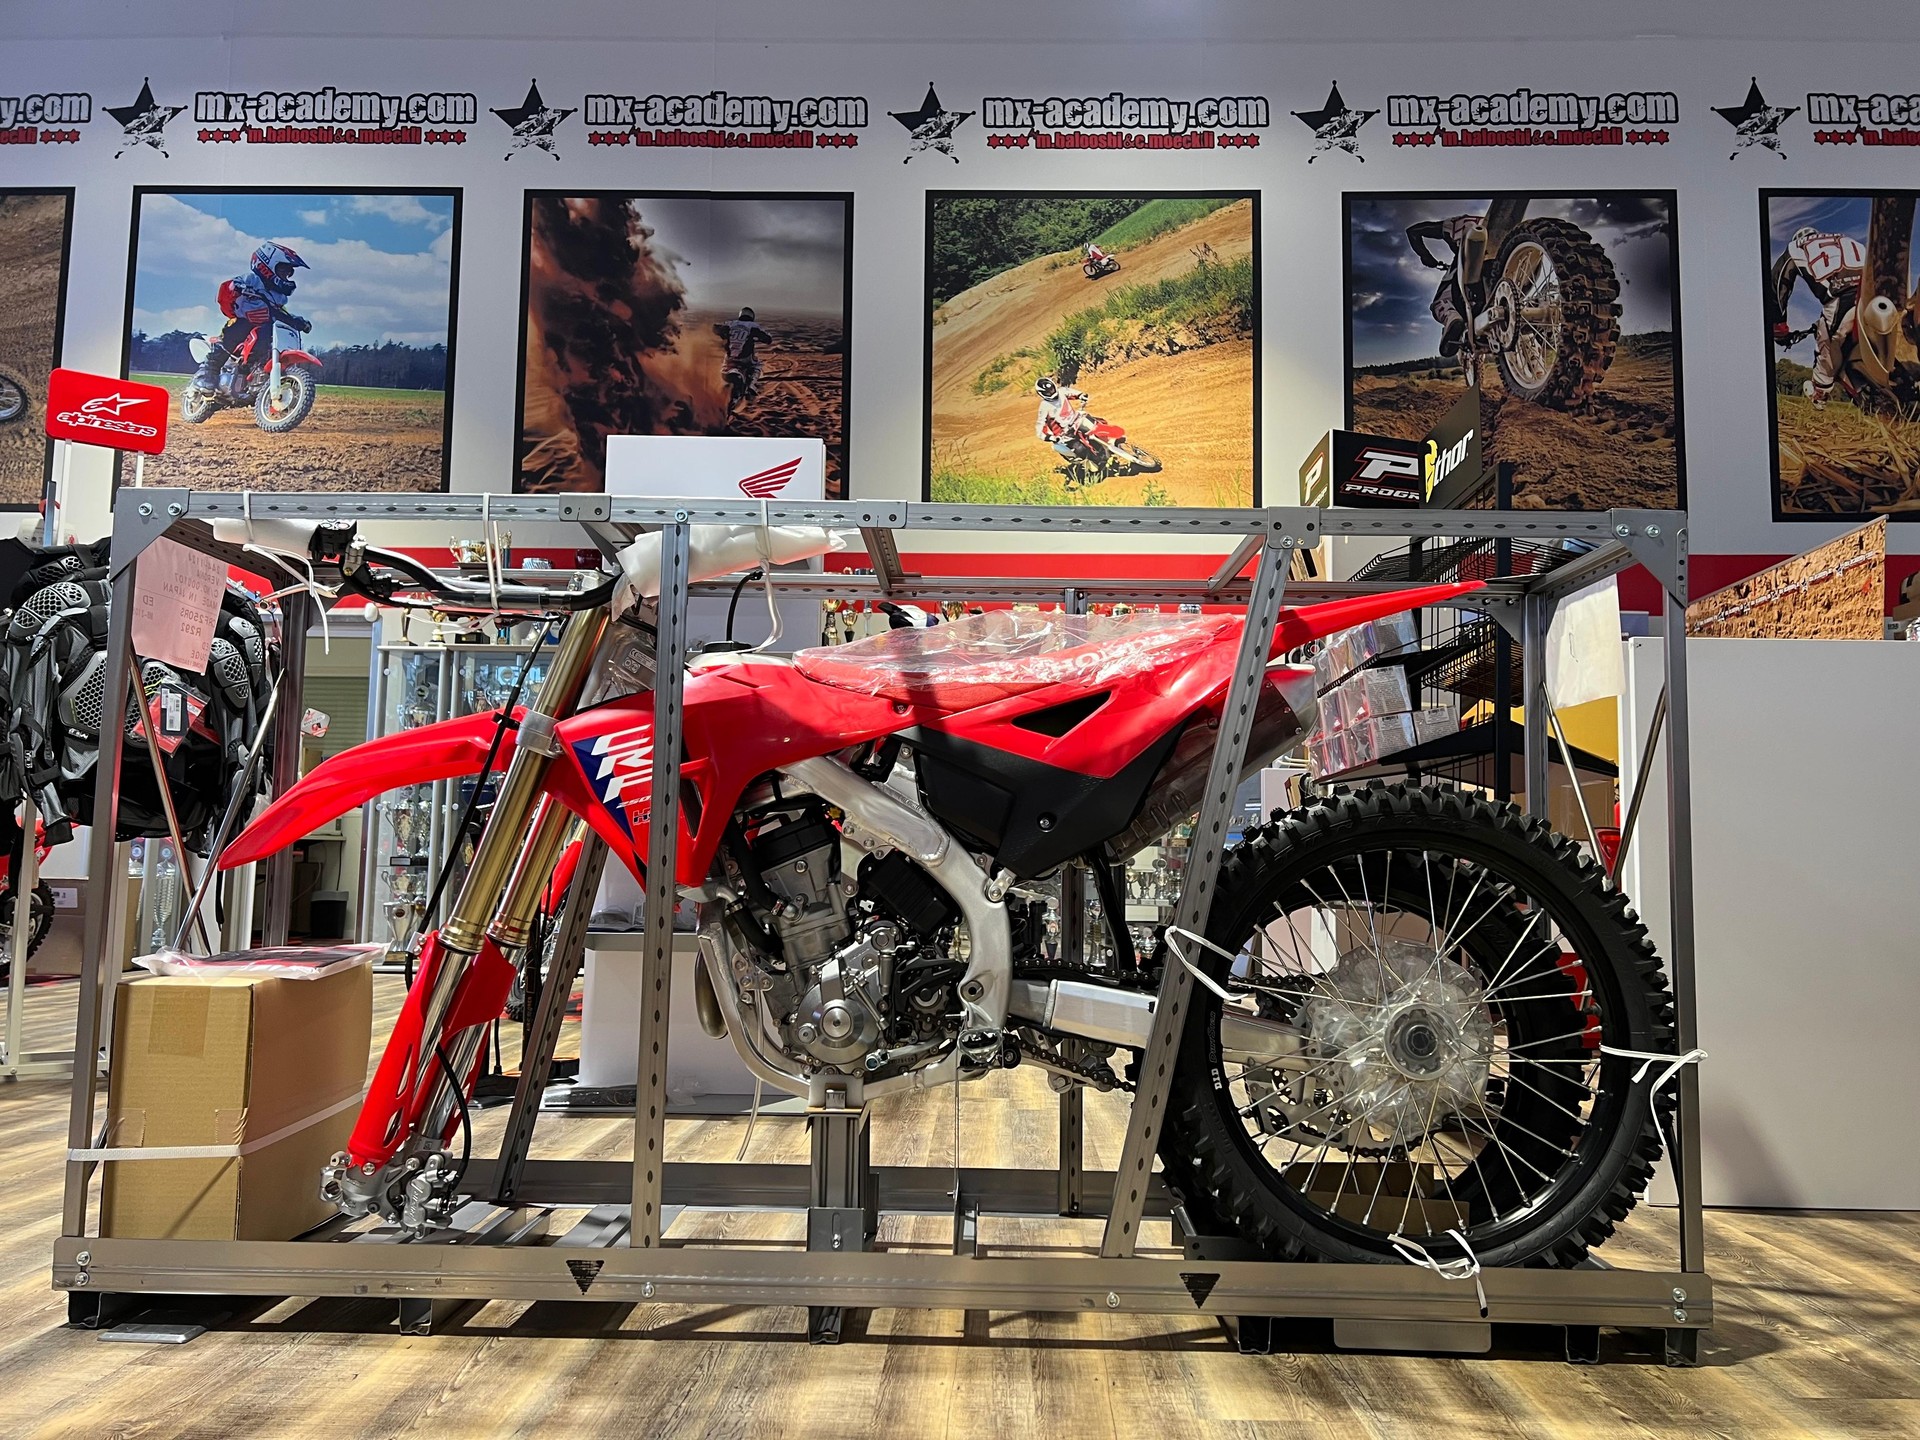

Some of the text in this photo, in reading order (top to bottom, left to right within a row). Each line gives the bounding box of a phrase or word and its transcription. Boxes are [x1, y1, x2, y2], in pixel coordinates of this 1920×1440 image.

[194, 87, 477, 129] mx-academy.com
[585, 91, 868, 133] mx-academy.com
[983, 92, 1270, 134] mx-academy.com
[1387, 88, 1679, 131] mx-academy.com
[57, 412, 158, 437] alpinestars
